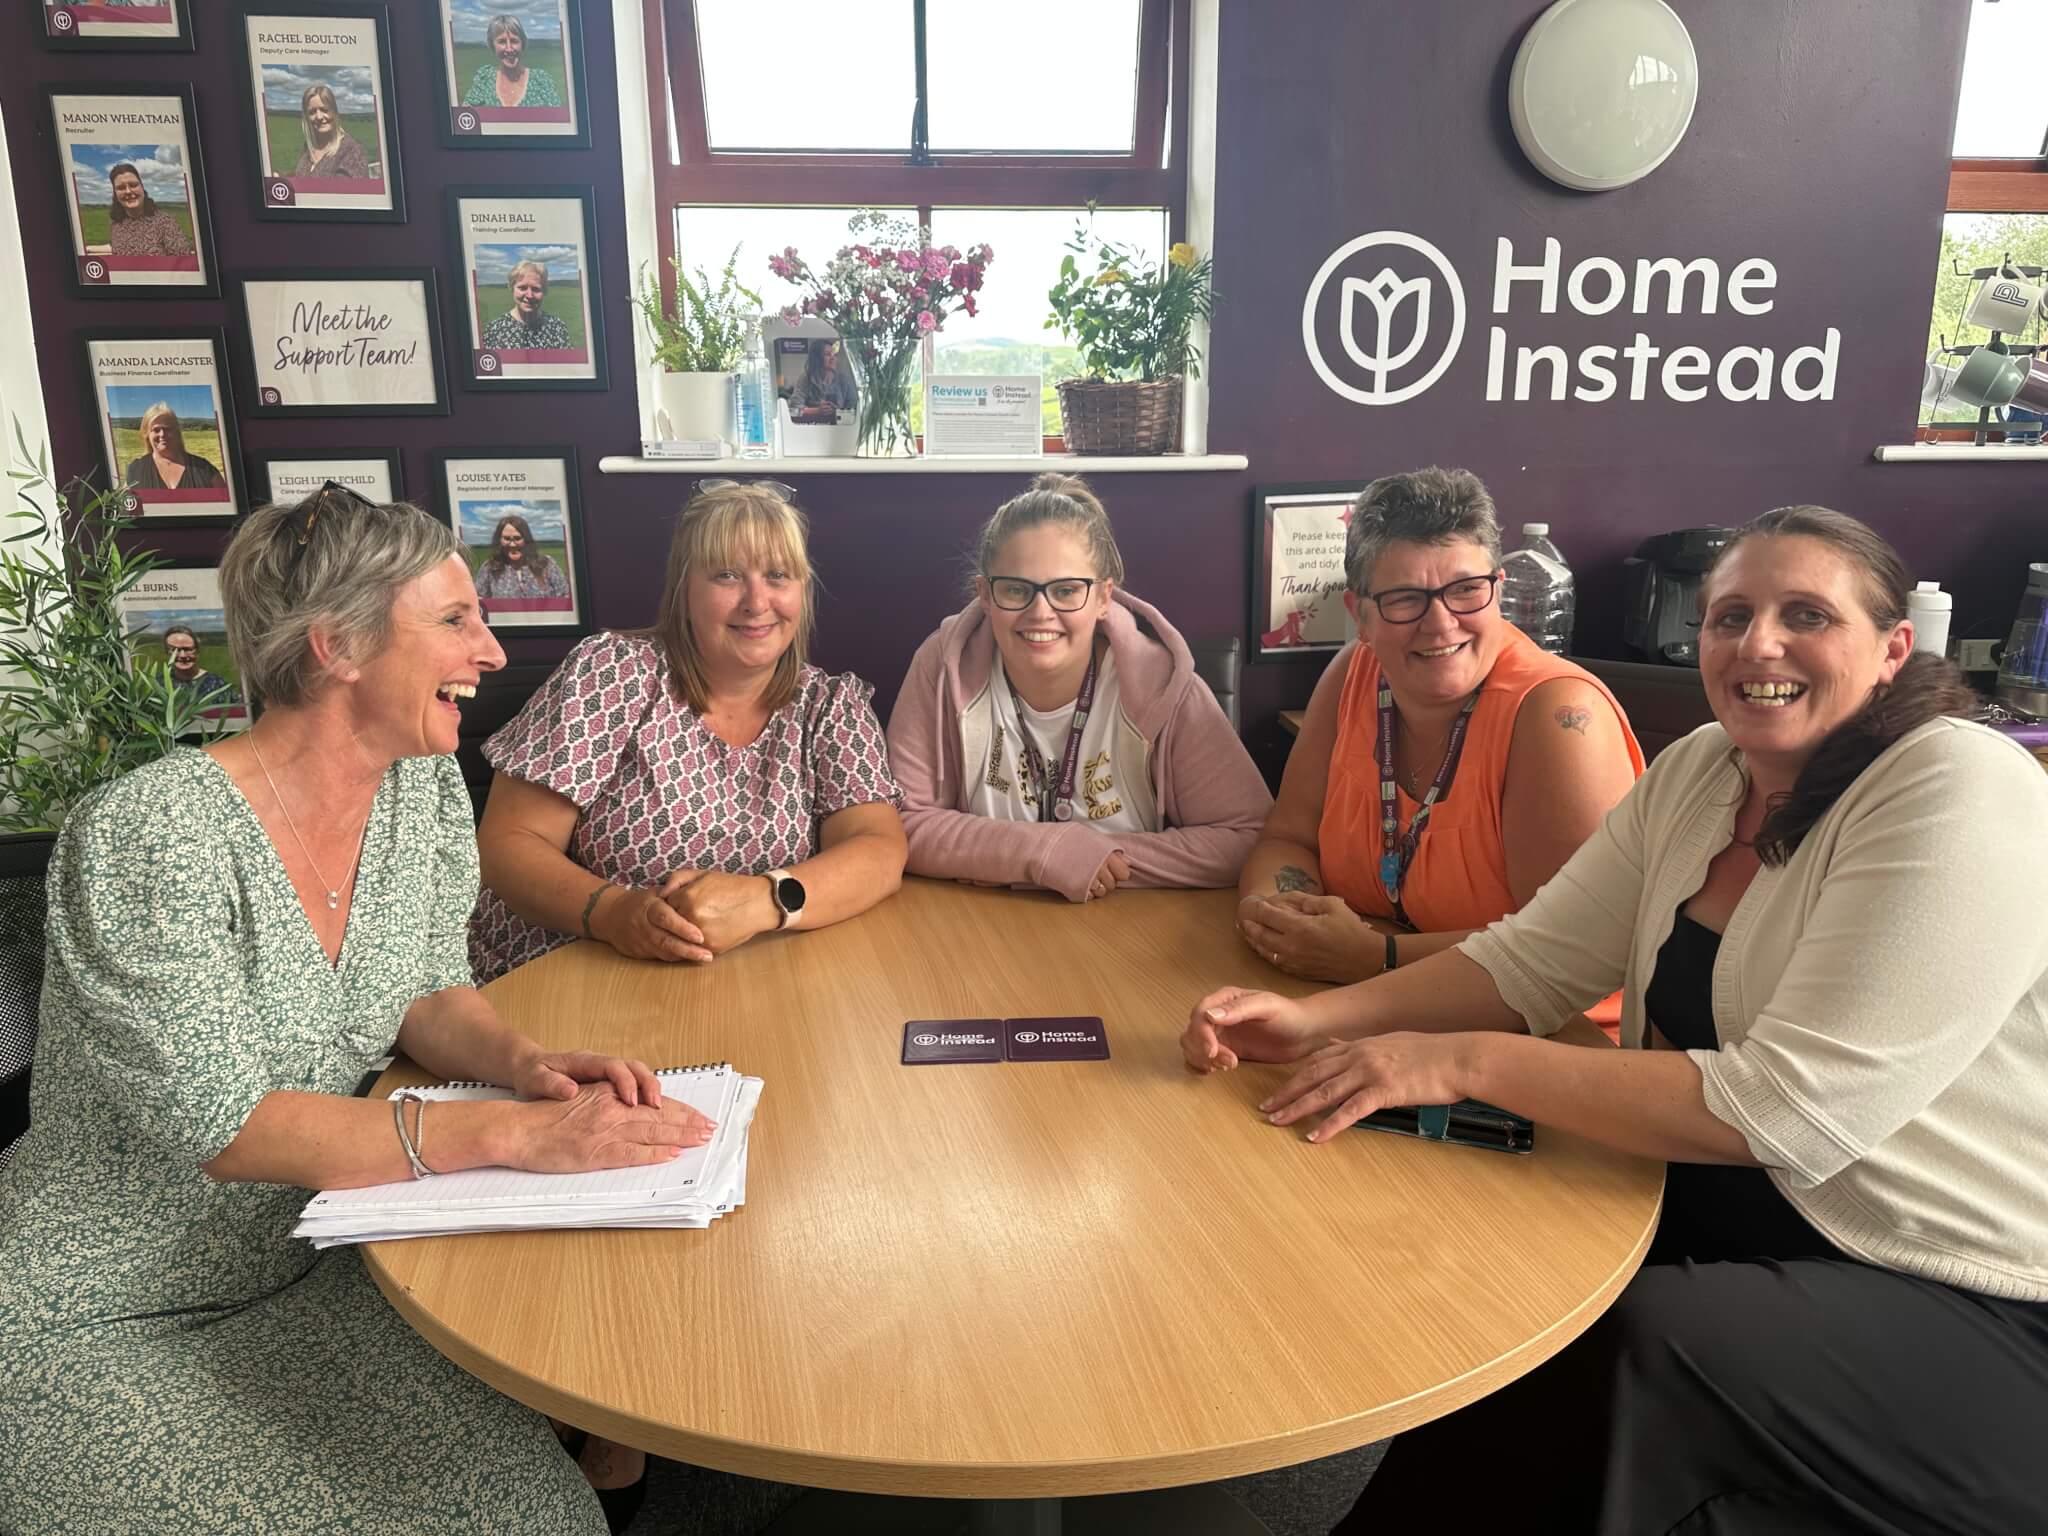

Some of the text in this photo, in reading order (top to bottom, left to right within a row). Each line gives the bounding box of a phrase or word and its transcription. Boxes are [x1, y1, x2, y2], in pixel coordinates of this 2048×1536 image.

[258, 33, 357, 45] RACHEL BOULTON
[260, 47, 283, 55] Deputy
[301, 48, 330, 56] Manager
[63, 113, 180, 124] MANON WHEATMAN
[471, 214, 536, 223] DINAH BALL
[1492, 236, 1778, 316] Home
[292, 300, 392, 336] Meet the
[274, 336, 417, 374] Support Team!
[98, 357, 213, 367] AMANDA LANCASTER
[1486, 326, 1841, 402] Instead
[931, 385, 988, 397] Review us
[279, 476, 309, 486] LEIGH
[456, 473, 526, 482] LOUISE YATES
[1292, 531, 1323, 542] Please
[1285, 545, 1346, 556] this area cle
[1298, 559, 1340, 571] and tidy!
[143, 583, 179, 592] BURNS
[1280, 575, 1322, 597] Thank
[1383, 712, 1392, 765] Home Instead
[1064, 733, 1080, 784] Home Instead
